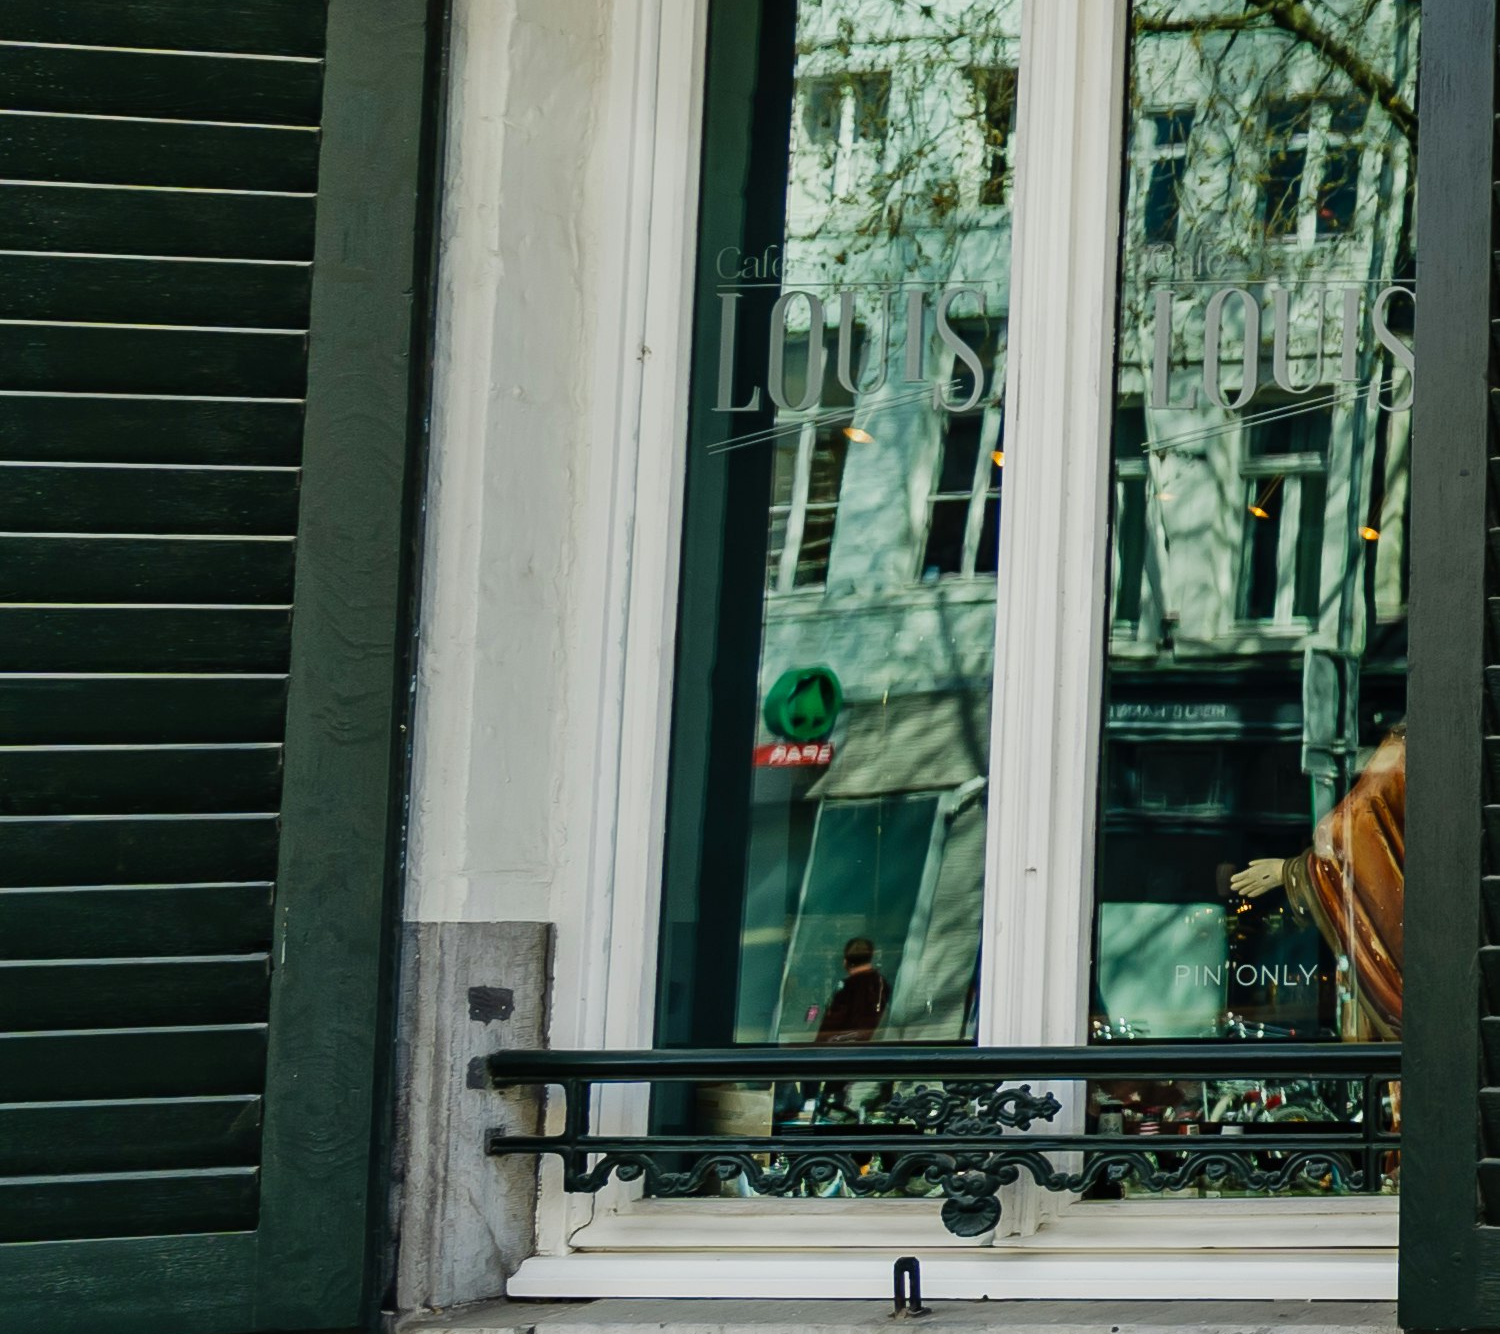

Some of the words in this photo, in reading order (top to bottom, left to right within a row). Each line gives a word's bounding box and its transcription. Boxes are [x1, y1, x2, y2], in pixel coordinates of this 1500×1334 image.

[712, 287, 986, 412] LOUIS
[1149, 286, 1416, 412] LOUIS
[1175, 964, 1222, 986] PIN
[1236, 964, 1318, 986] ONLY
